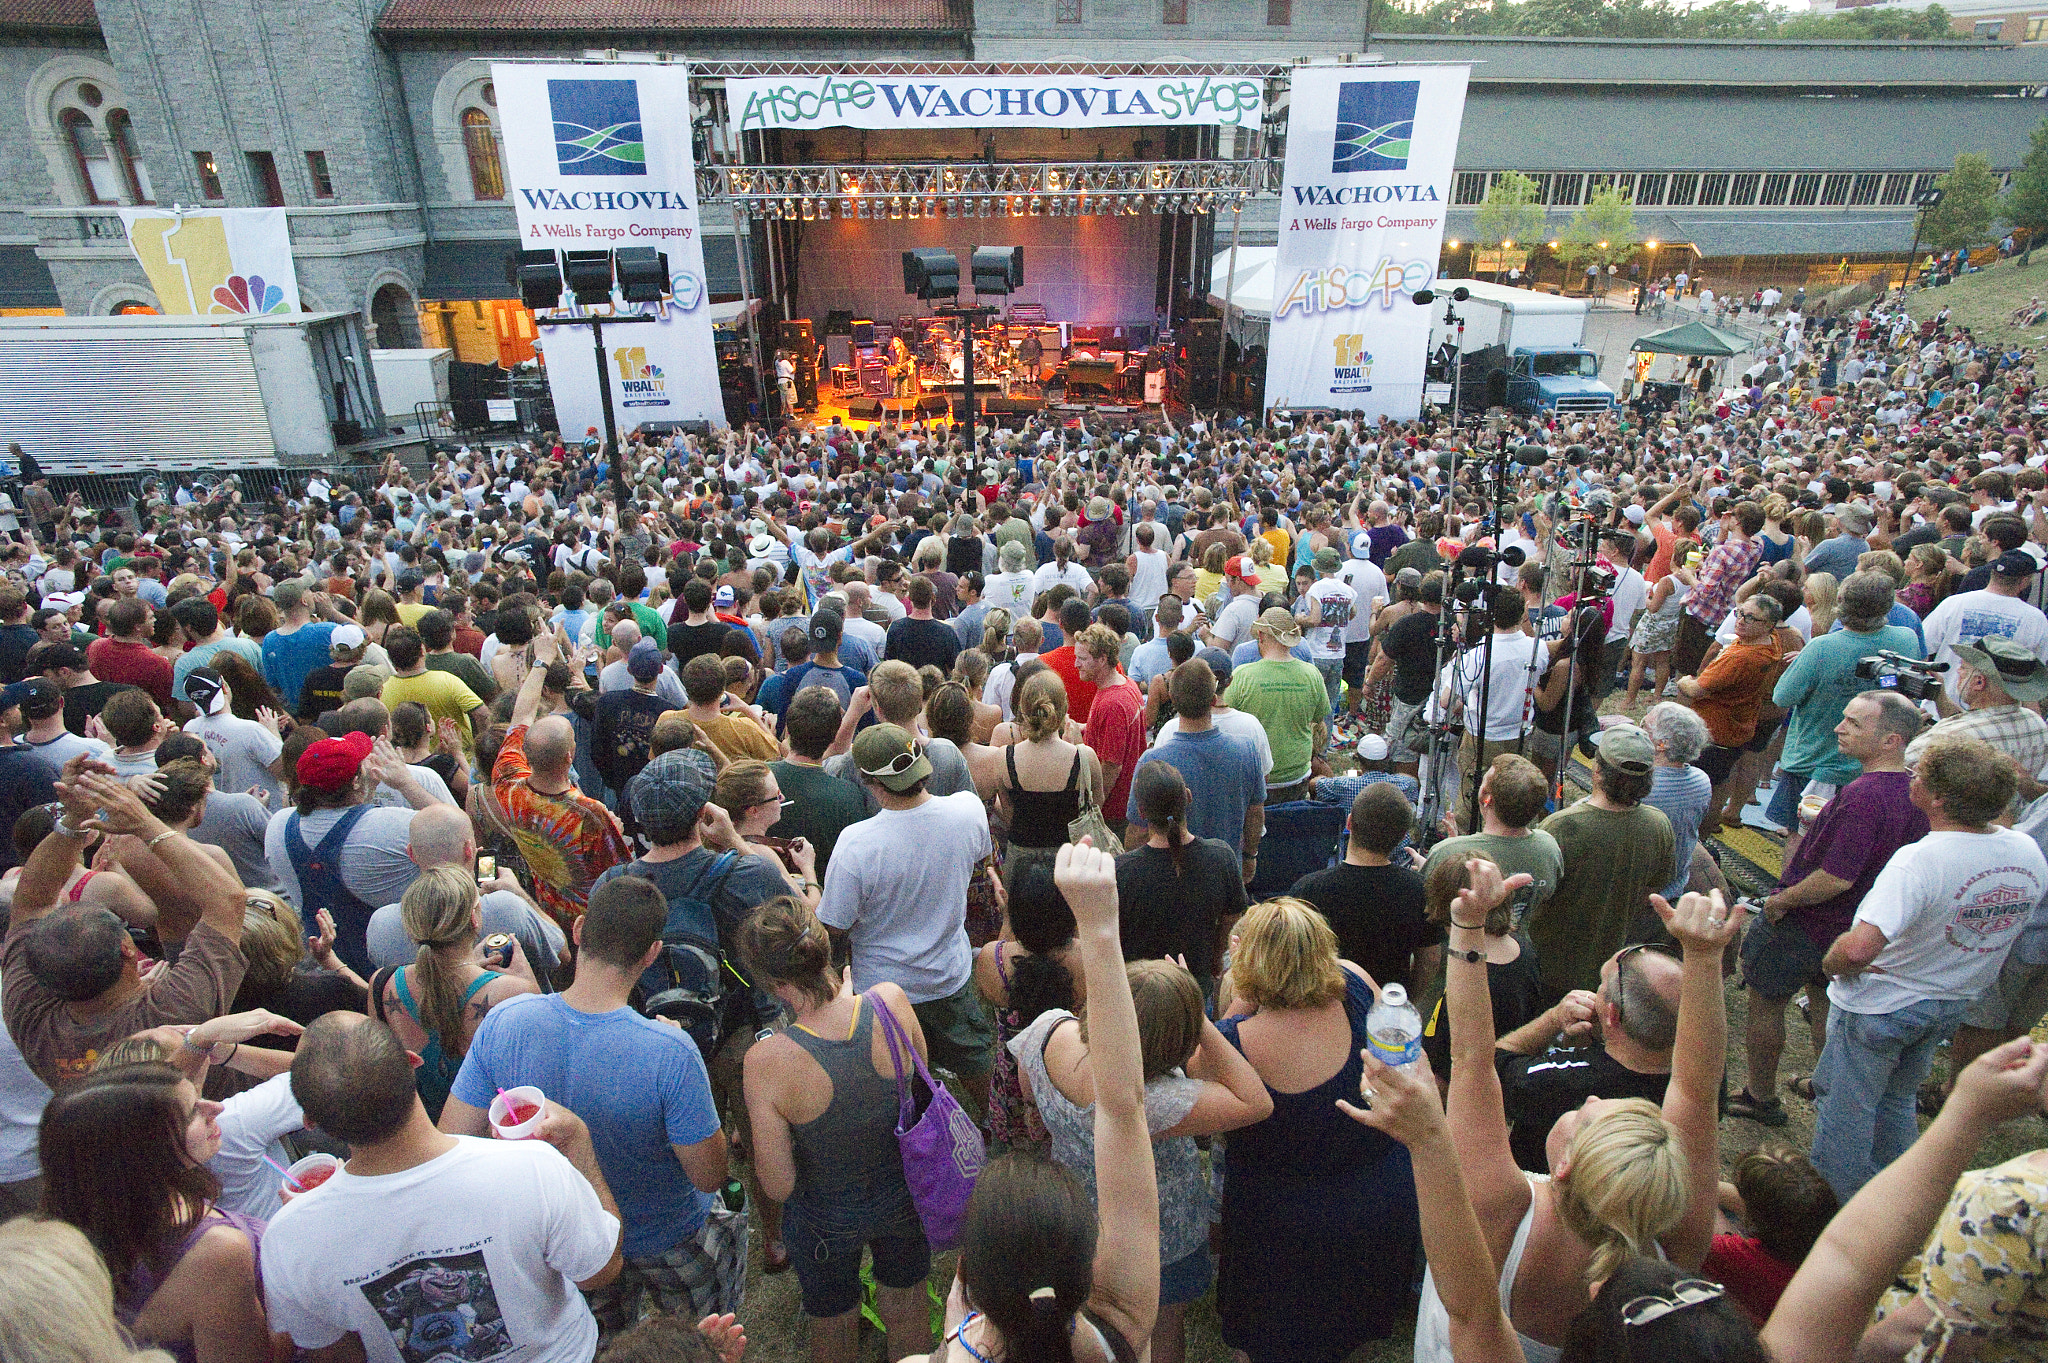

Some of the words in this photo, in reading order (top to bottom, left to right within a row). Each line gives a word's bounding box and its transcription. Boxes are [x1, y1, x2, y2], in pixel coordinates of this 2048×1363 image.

[876, 84, 1159, 118] WACHOVIA
[519, 188, 689, 210] WACHOVIA
[1291, 185, 1440, 206] WACHOVIA
[530, 224, 541, 237] A
[544, 224, 582, 237] Wells
[586, 224, 625, 240] Fargo
[629, 223, 693, 240] Company
[1290, 219, 1300, 230] A
[1304, 217, 1336, 231] Wells
[1341, 217, 1373, 231] Fargo
[1377, 215, 1438, 230] Company
